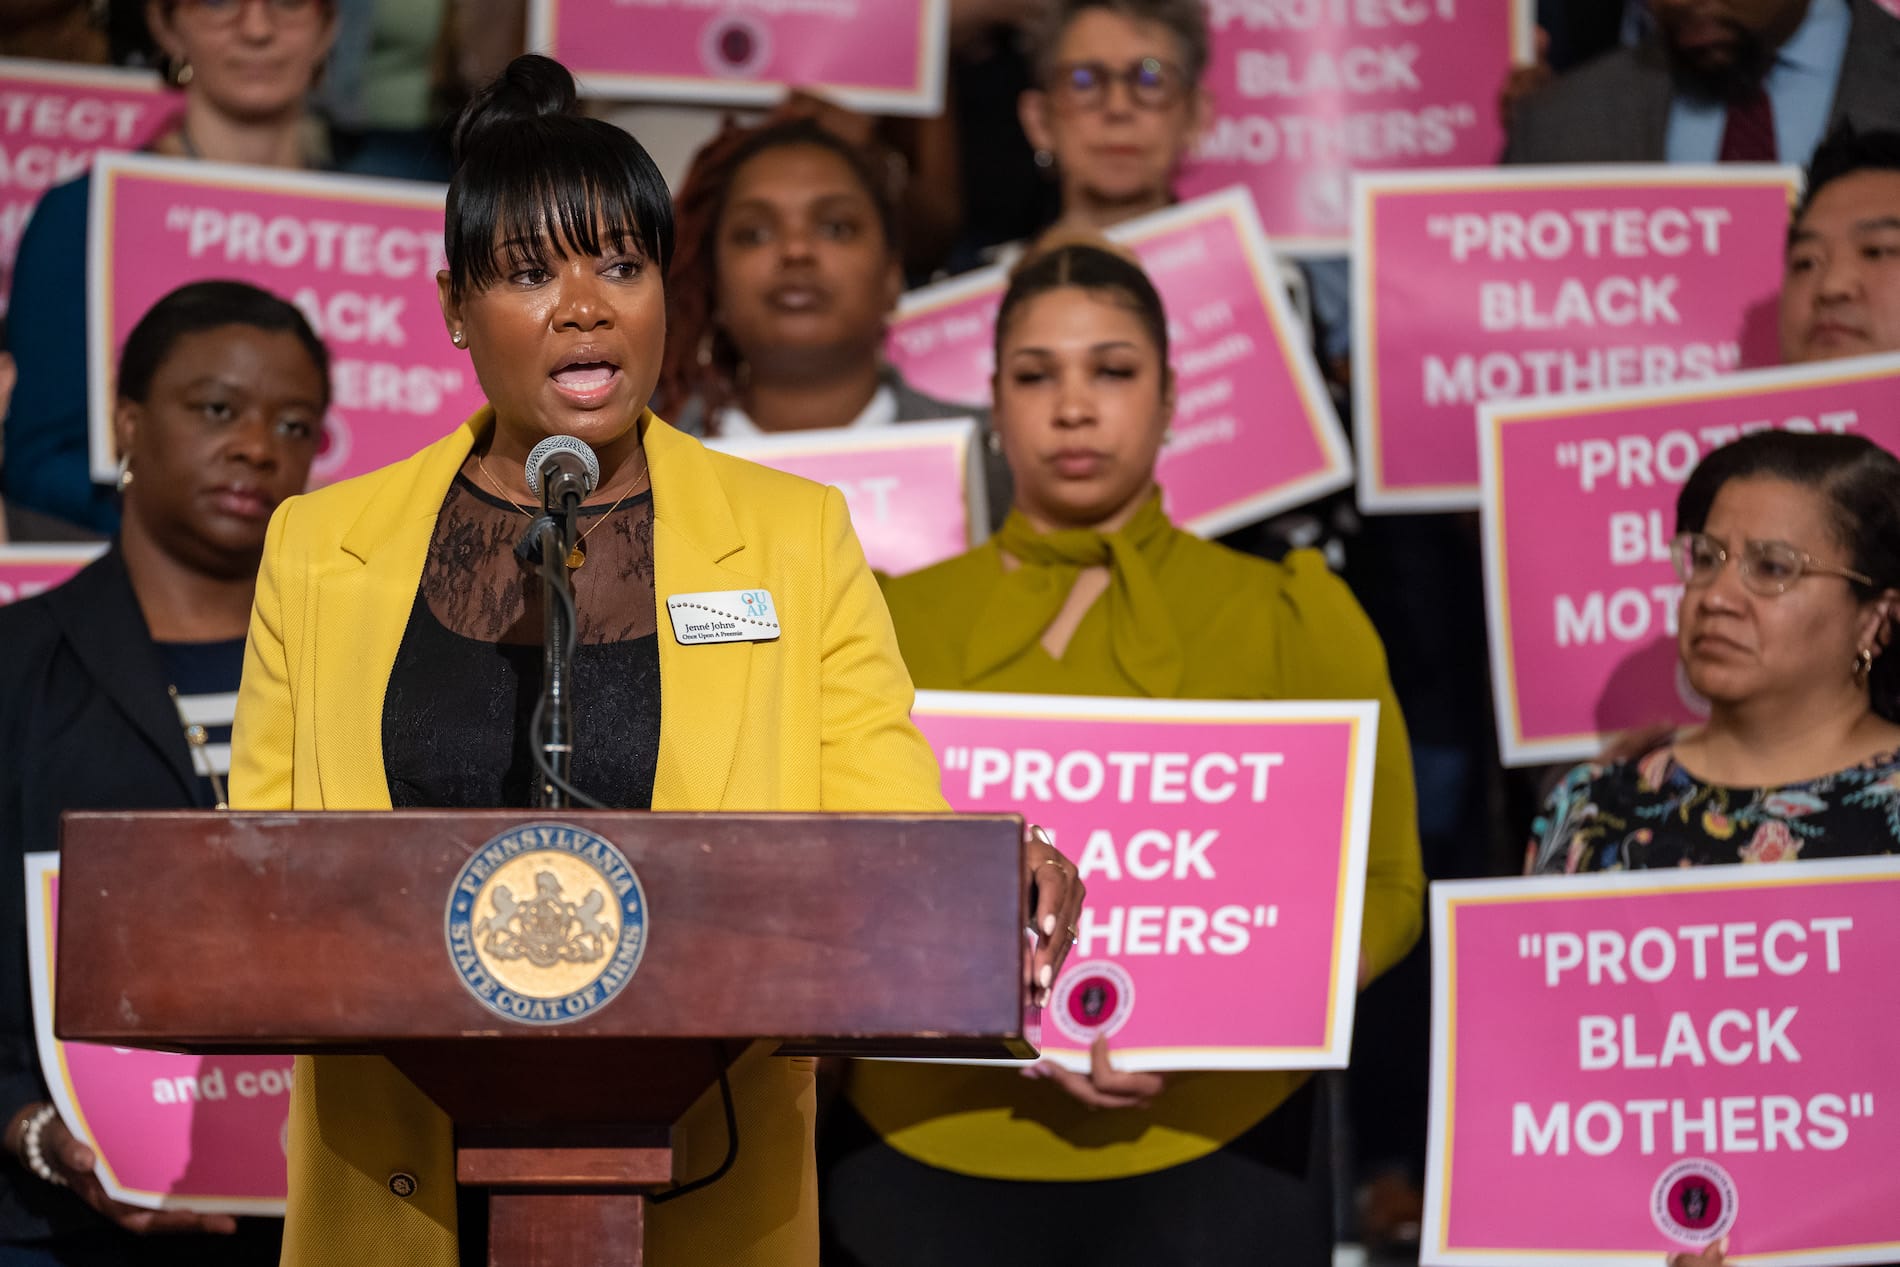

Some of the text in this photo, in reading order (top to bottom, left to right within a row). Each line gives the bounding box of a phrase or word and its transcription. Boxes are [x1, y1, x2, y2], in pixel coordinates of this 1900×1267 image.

[1236, 43, 1418, 98] BLACK
[166, 204, 449, 281] "PROTECT
[1426, 206, 1732, 263] "PROTECT
[1478, 274, 1680, 332] BLACK
[1422, 342, 1741, 406] MOTHERS"
[685, 621, 736, 633] Jenné Johns
[945, 747, 1284, 803] "PROTECT
[460, 828, 633, 896] PENNSYLVANIA
[450, 923, 641, 1019] STATE COAT OF ARMS
[1518, 917, 1854, 987] "PROTECT
[1578, 1006, 1801, 1071] BLACK
[152, 1067, 228, 1103] and
[1511, 1093, 1875, 1156] MOTHERS"
